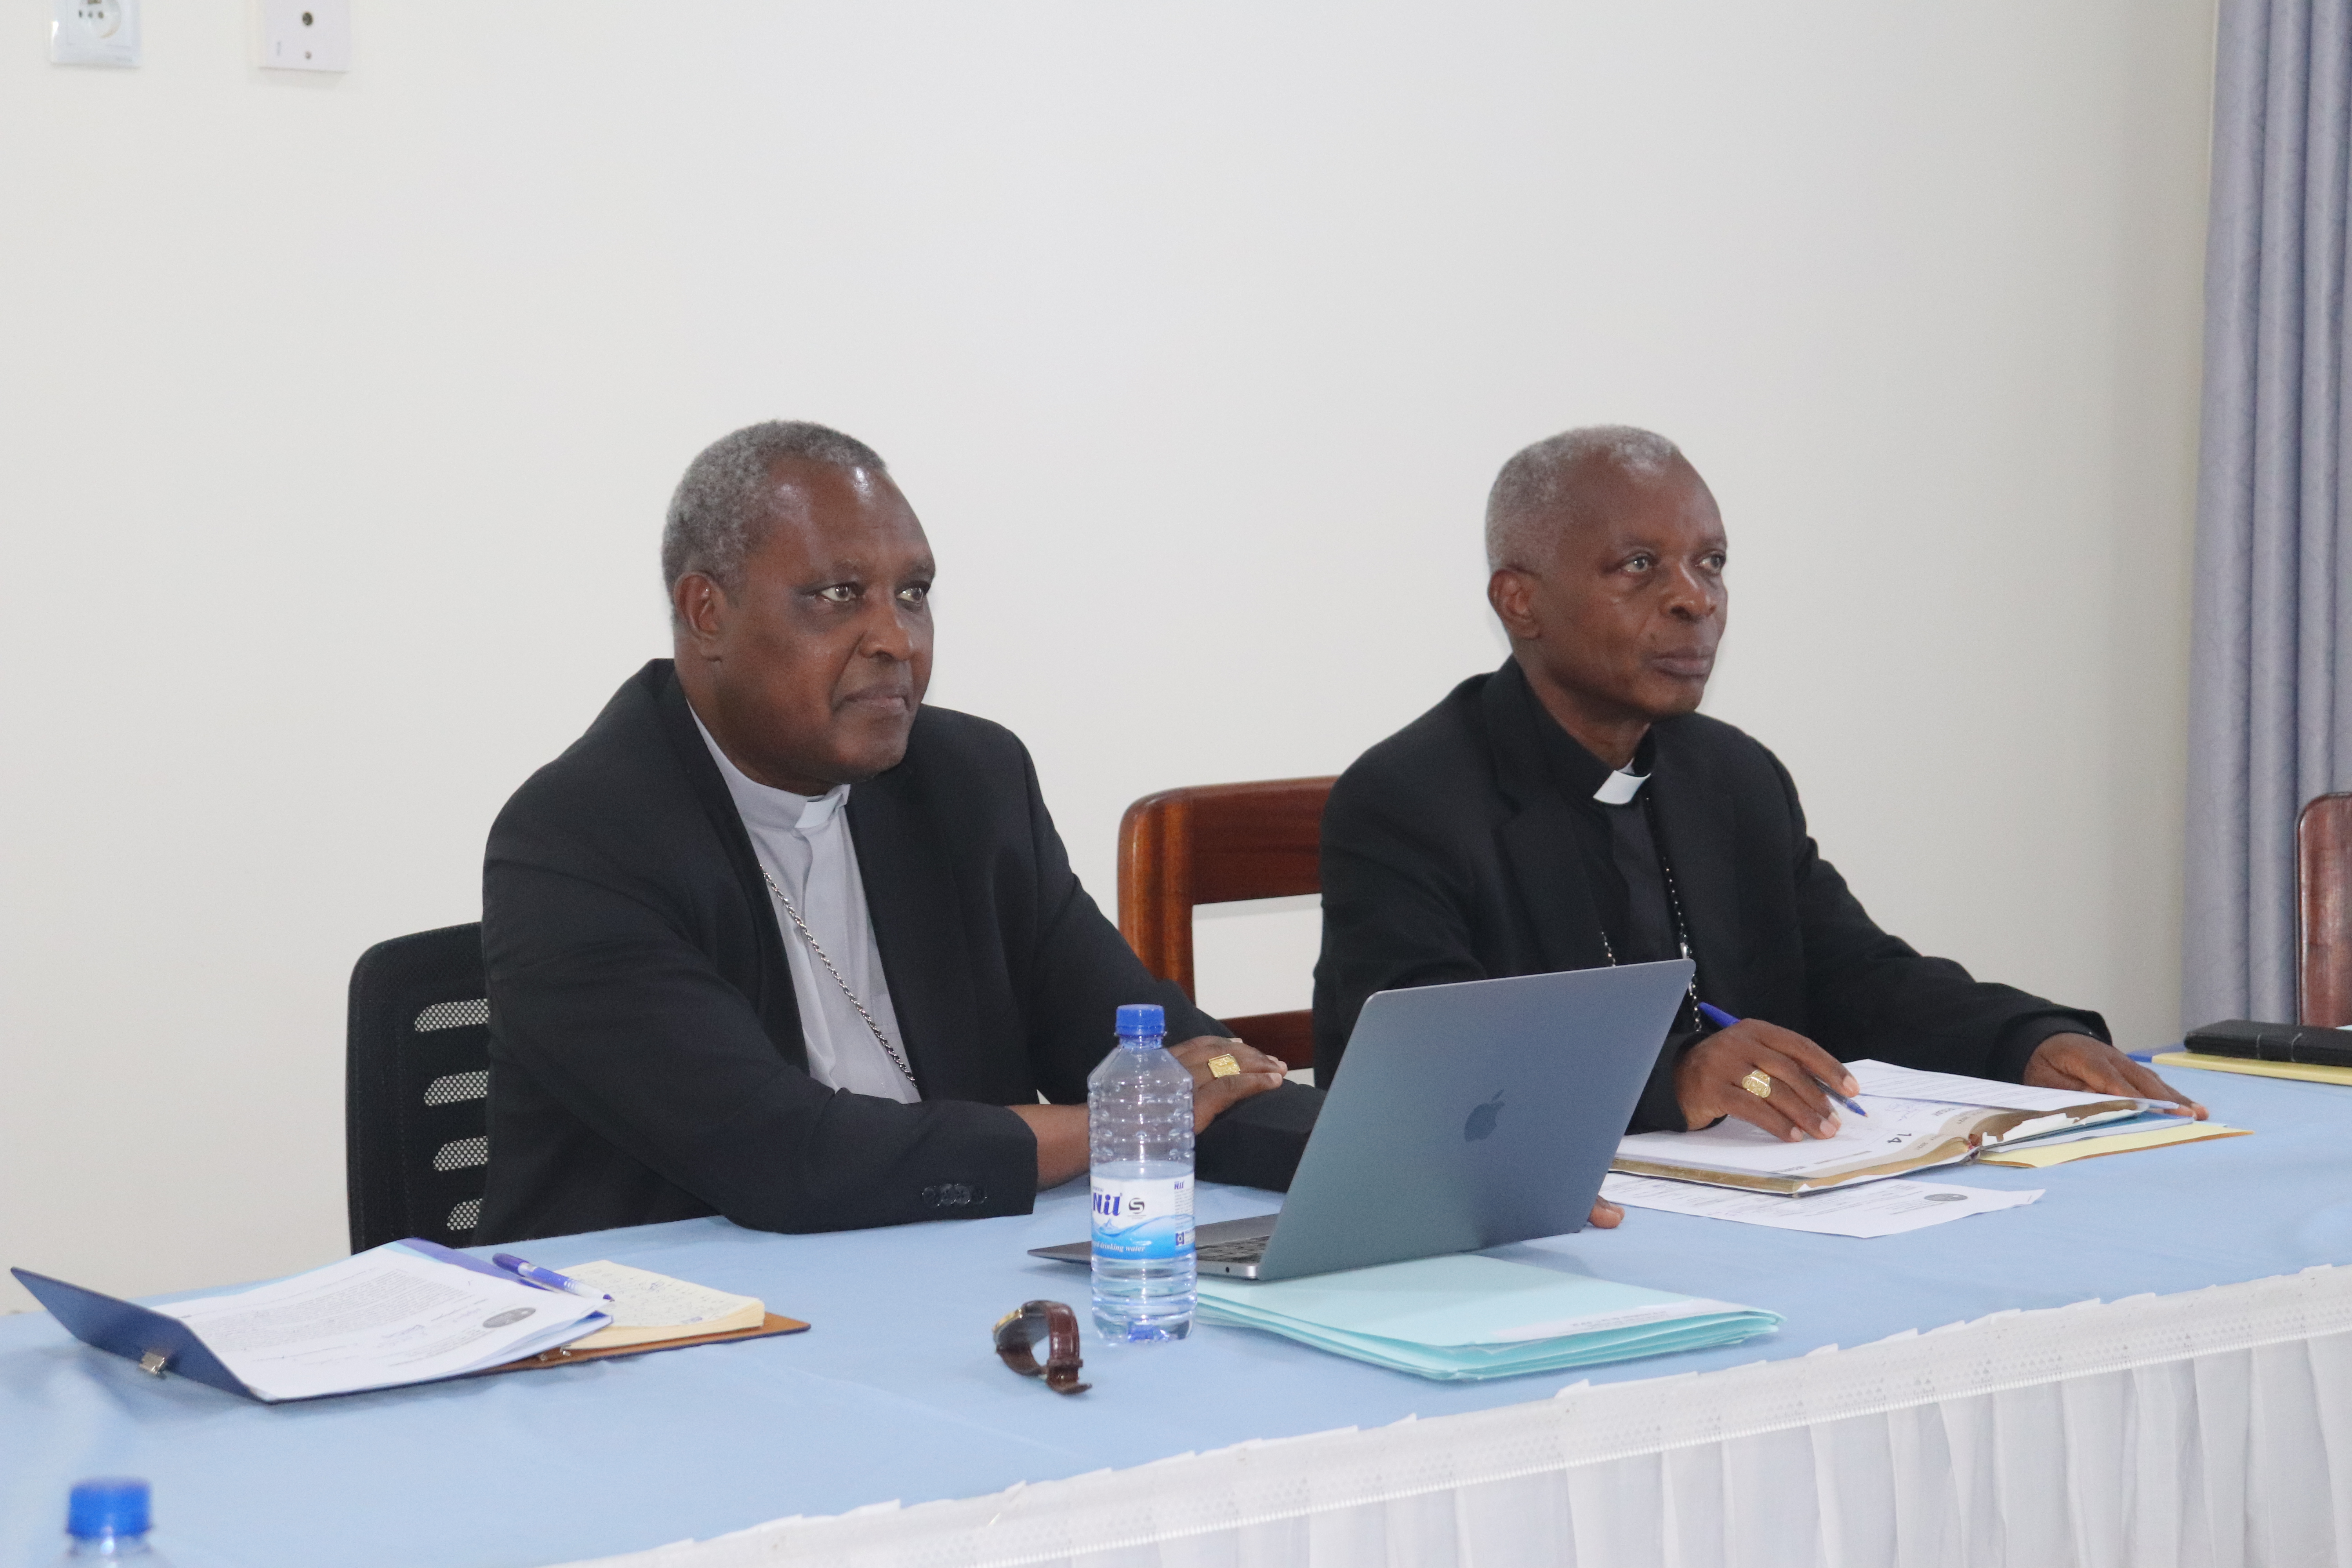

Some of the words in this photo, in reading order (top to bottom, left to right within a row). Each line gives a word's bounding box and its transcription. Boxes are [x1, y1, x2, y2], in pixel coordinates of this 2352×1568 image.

[1886, 1133, 1912, 1143] 14
[1093, 1192, 1121, 1216] Nil
[1100, 1242, 1124, 1252] drinking
